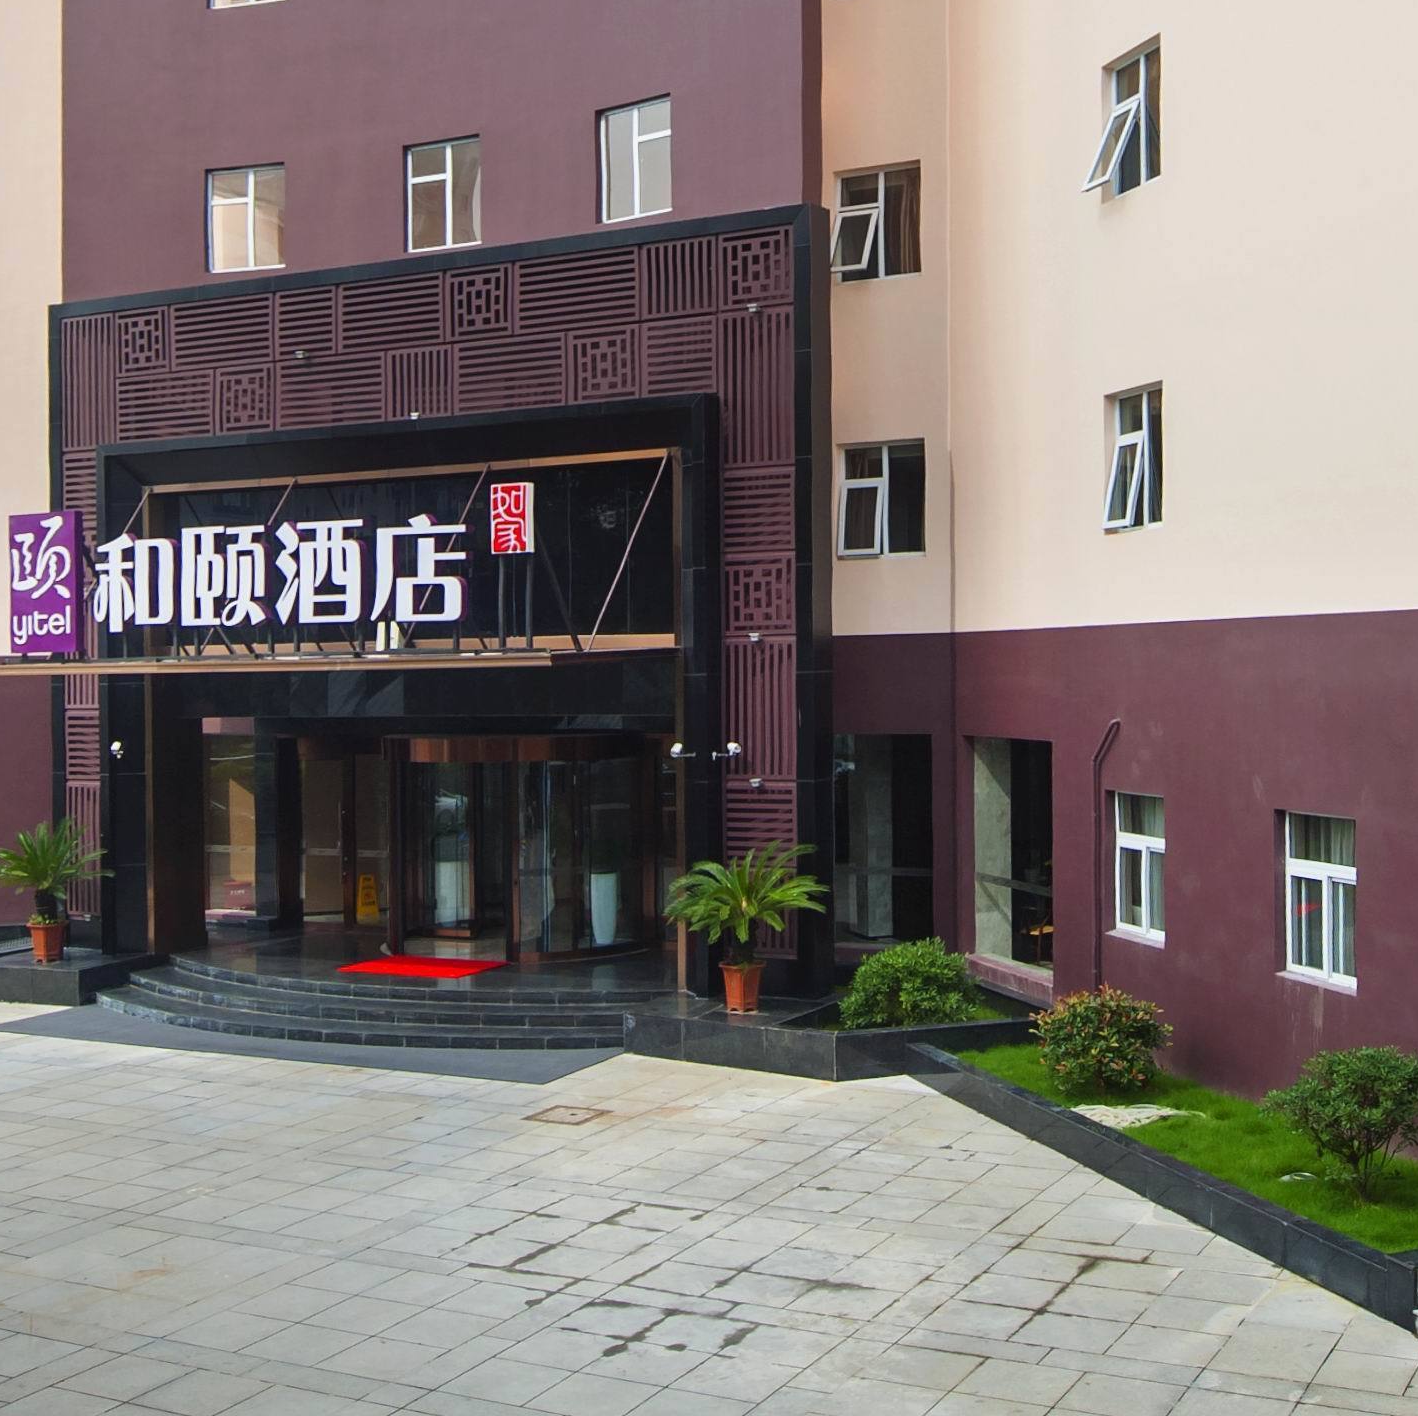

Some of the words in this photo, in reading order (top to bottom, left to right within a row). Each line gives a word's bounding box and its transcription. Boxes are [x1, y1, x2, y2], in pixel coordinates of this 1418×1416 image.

[93, 514, 467, 633] 和颐酒店
[12, 605, 71, 645] yitel
